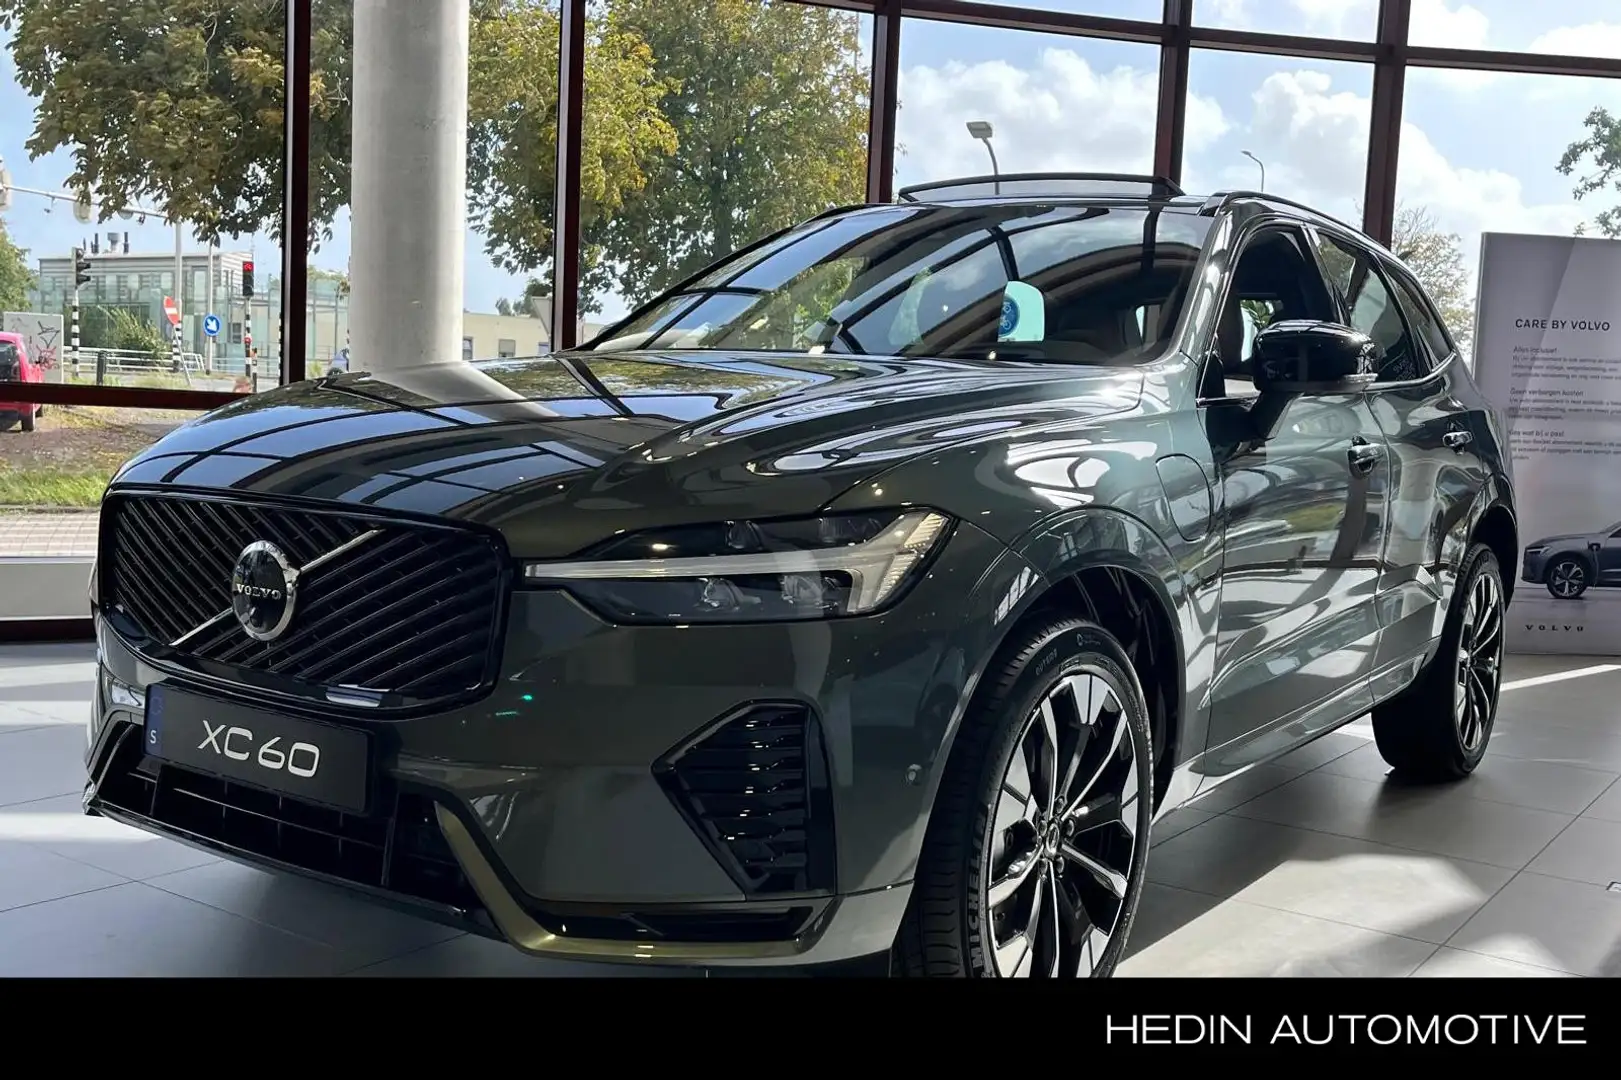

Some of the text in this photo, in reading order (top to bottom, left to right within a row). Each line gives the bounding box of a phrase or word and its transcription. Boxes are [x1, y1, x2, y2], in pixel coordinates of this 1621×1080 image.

[1515, 318, 1611, 331] CARE BY VOLVO
[236, 583, 281, 600] VOLVO
[1525, 624, 1584, 632] VOLVO
[150, 729, 157, 744] S
[197, 719, 320, 778] XC60
